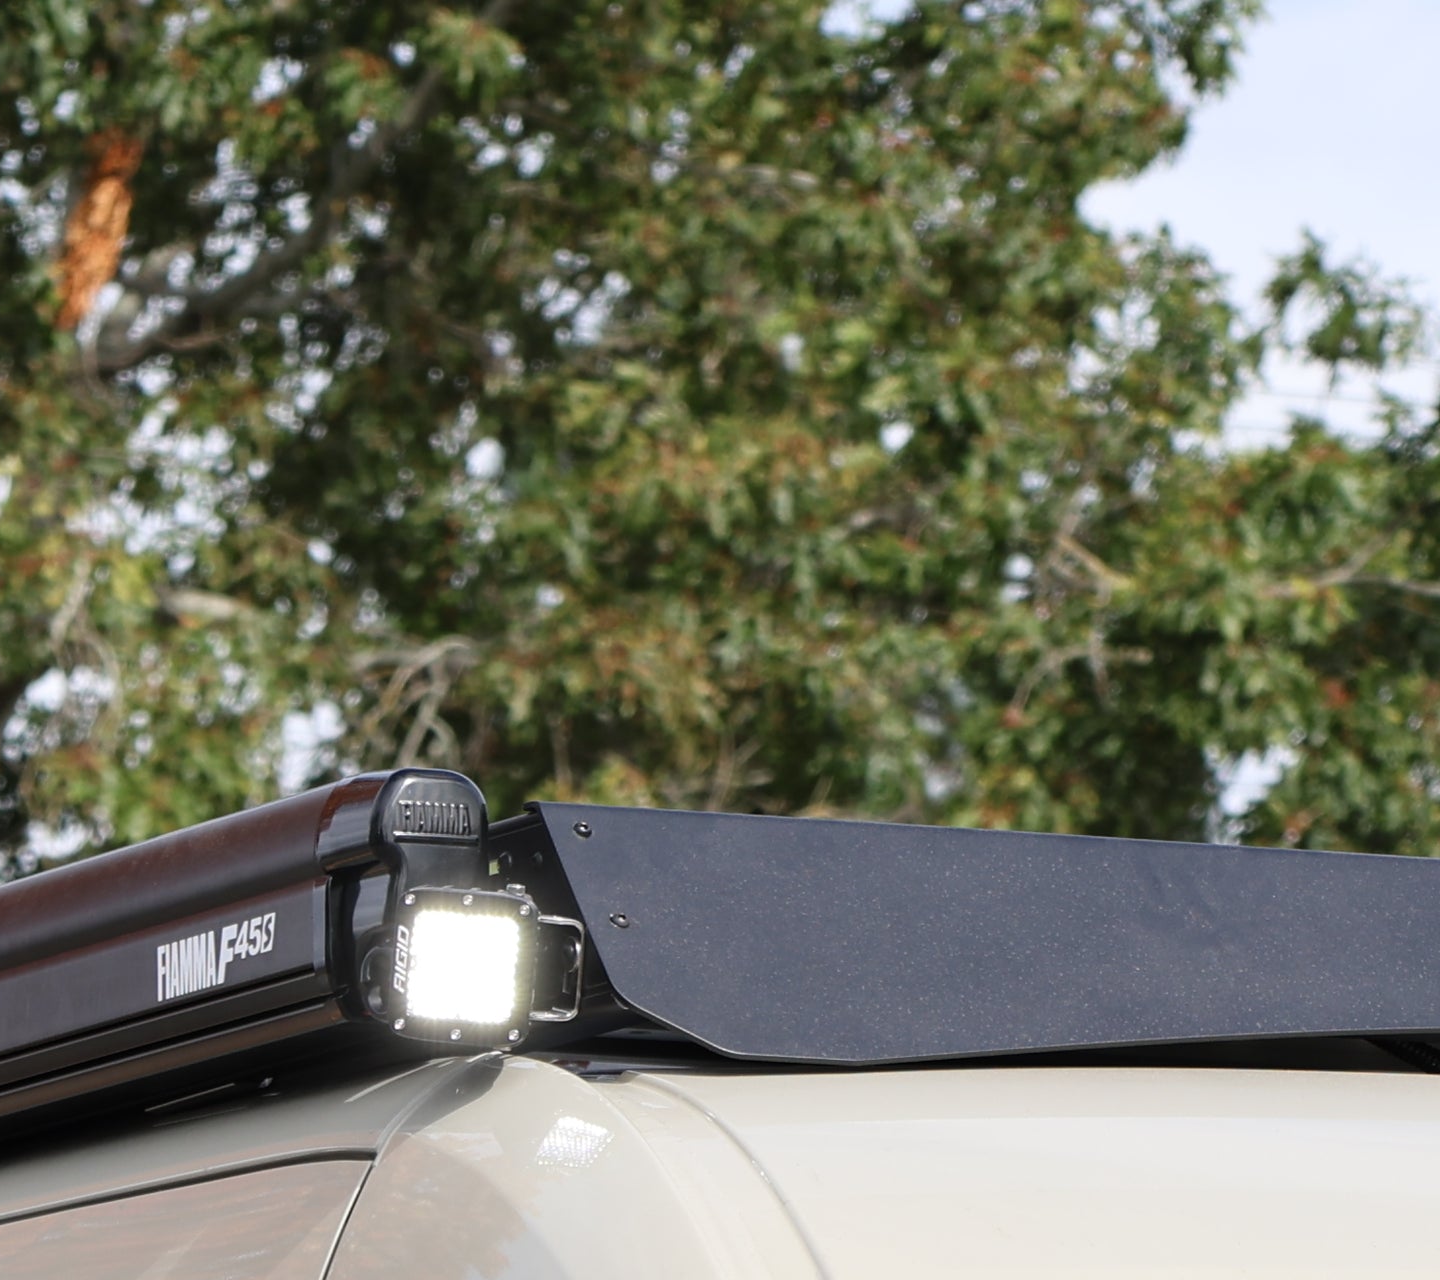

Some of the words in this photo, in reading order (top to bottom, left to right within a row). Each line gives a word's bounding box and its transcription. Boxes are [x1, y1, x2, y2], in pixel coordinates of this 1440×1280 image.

[397, 800, 472, 834] FIAMMA
[157, 930, 217, 1002] FIAMMA
[393, 924, 410, 994] RIGID
